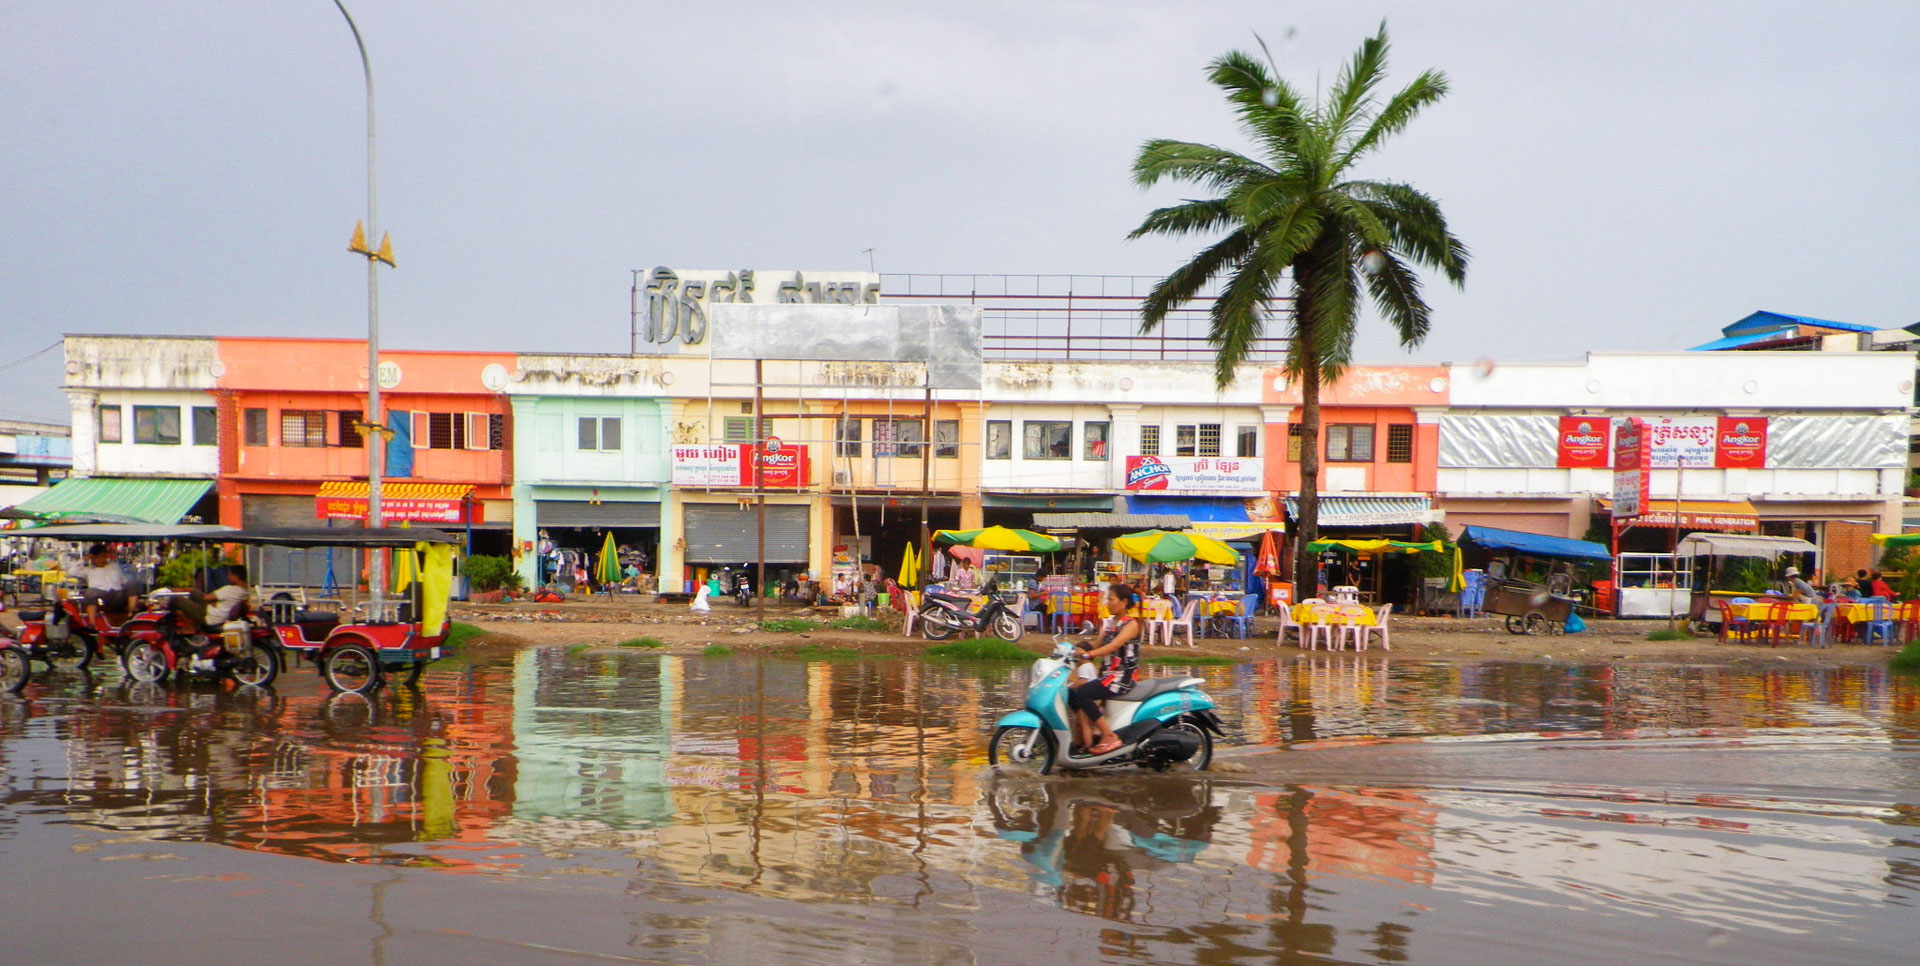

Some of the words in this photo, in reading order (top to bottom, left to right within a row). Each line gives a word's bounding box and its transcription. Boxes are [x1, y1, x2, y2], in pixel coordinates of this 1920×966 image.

[1566, 434, 1603, 446] Angkor
[1723, 434, 1760, 446] Angkor
[1695, 516, 1712, 524] PINK
[1714, 516, 1756, 526] GENERATION
